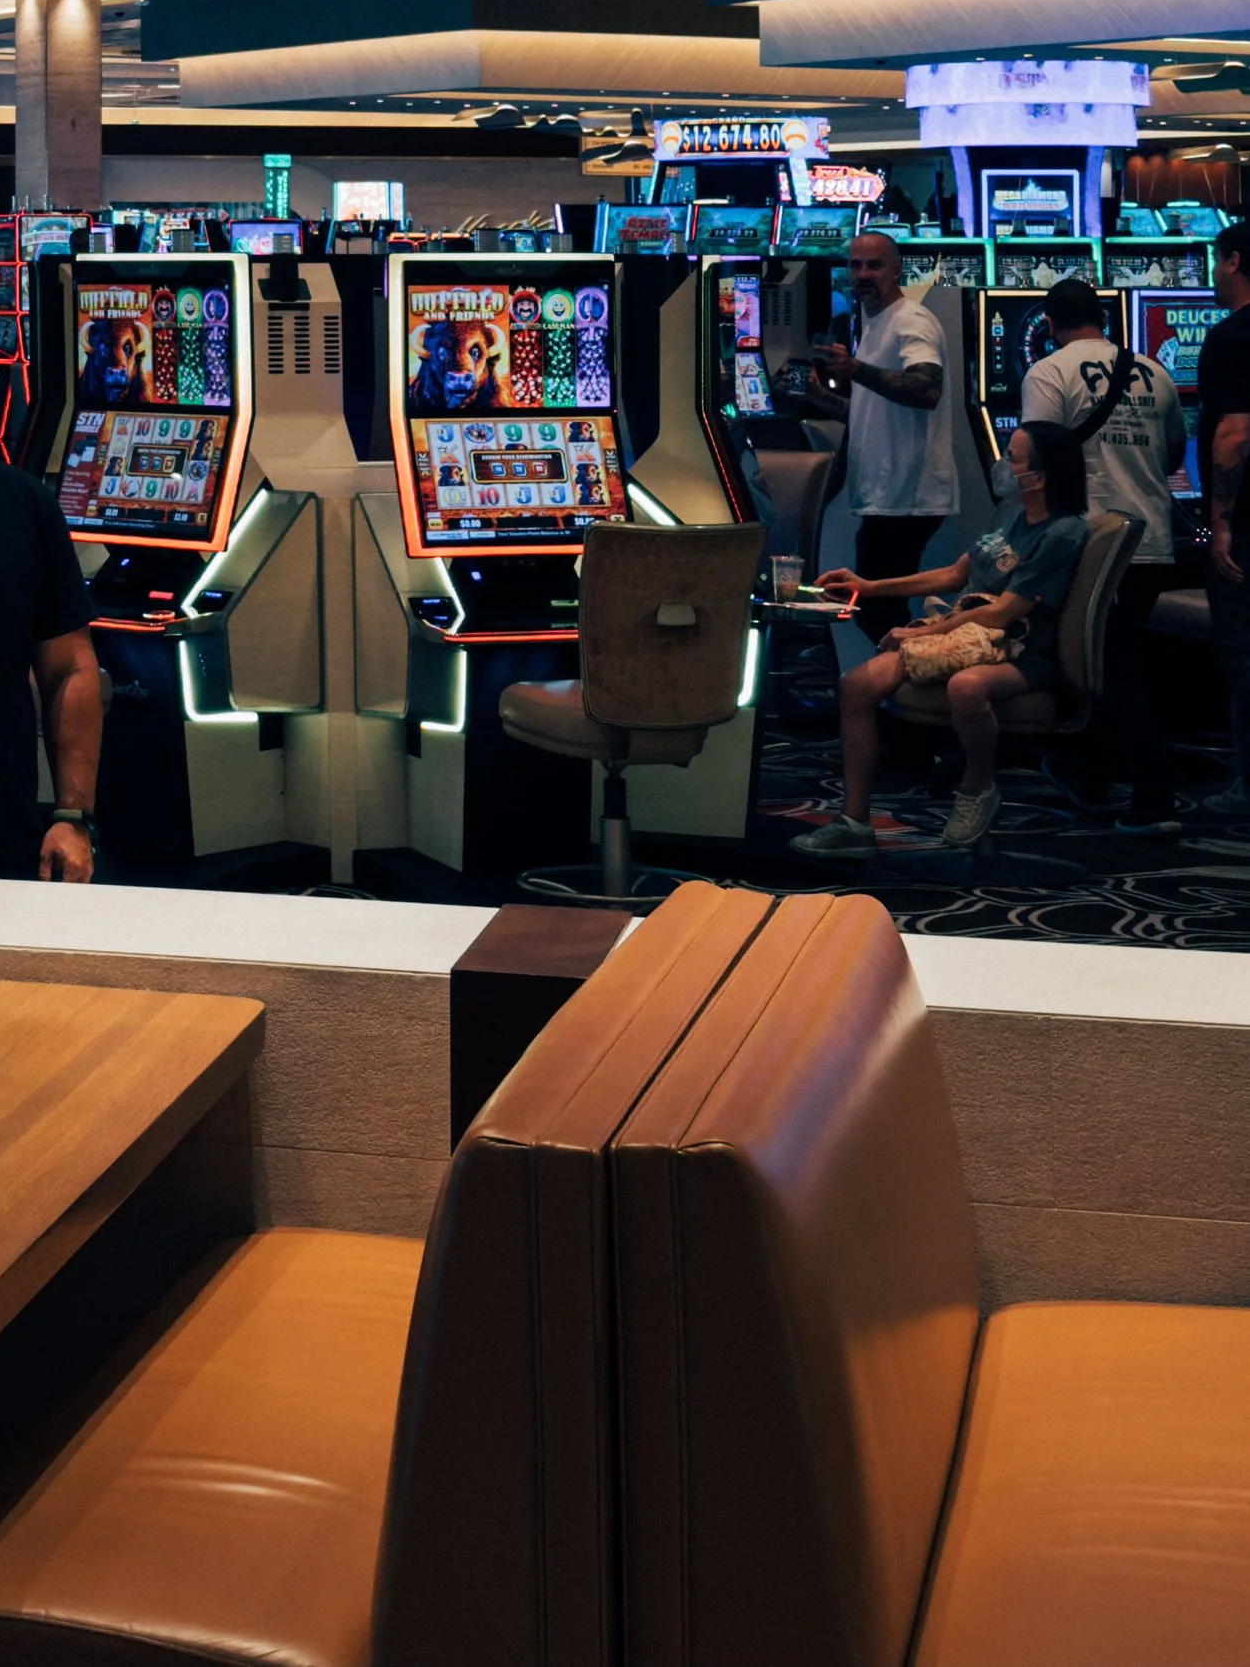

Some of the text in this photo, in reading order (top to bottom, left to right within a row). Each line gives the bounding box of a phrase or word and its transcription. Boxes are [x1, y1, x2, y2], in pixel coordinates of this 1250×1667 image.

[423, 312, 495, 321] AND FRIENDS
[76, 412, 105, 425] STN
[995, 417, 1018, 428] STN
[158, 419, 171, 437] 9
[179, 420, 192, 438] 9
[503, 424, 523, 442] 9
[537, 423, 557, 442] 9
[145, 479, 158, 498] 9
[478, 487, 500, 505] 10
